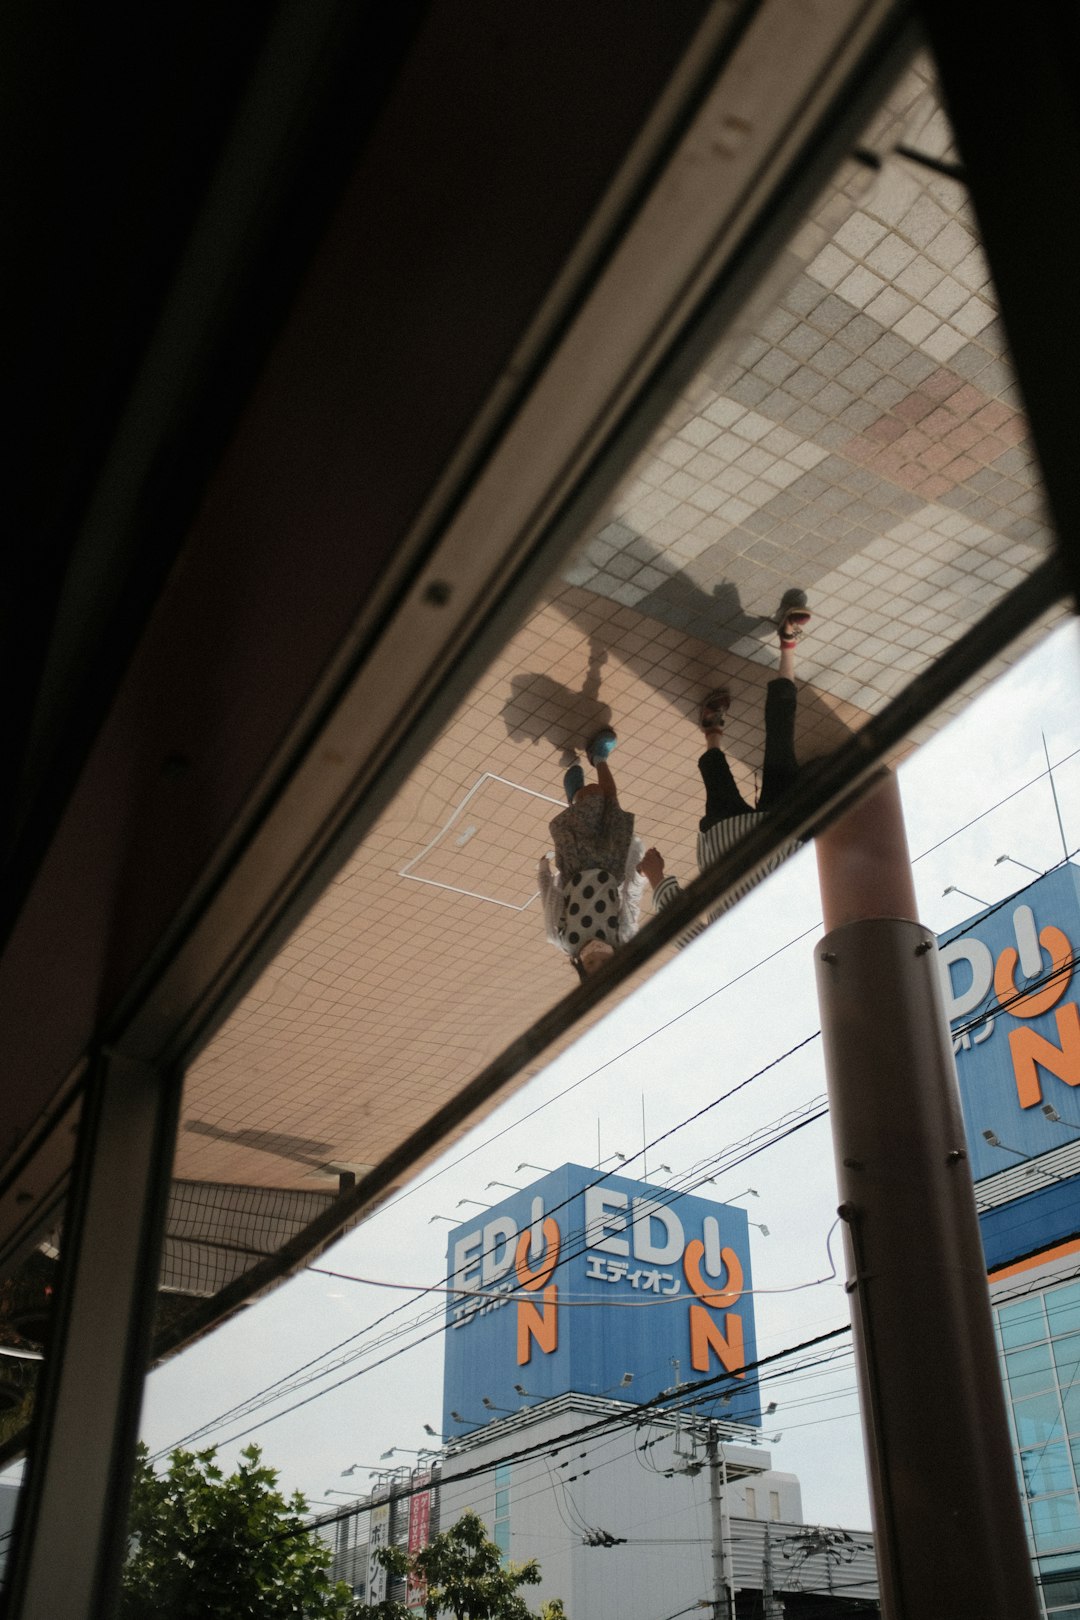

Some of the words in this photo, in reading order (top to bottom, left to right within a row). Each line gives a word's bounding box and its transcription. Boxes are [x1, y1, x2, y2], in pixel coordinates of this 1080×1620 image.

[586, 1255, 681, 1295] エディオン
